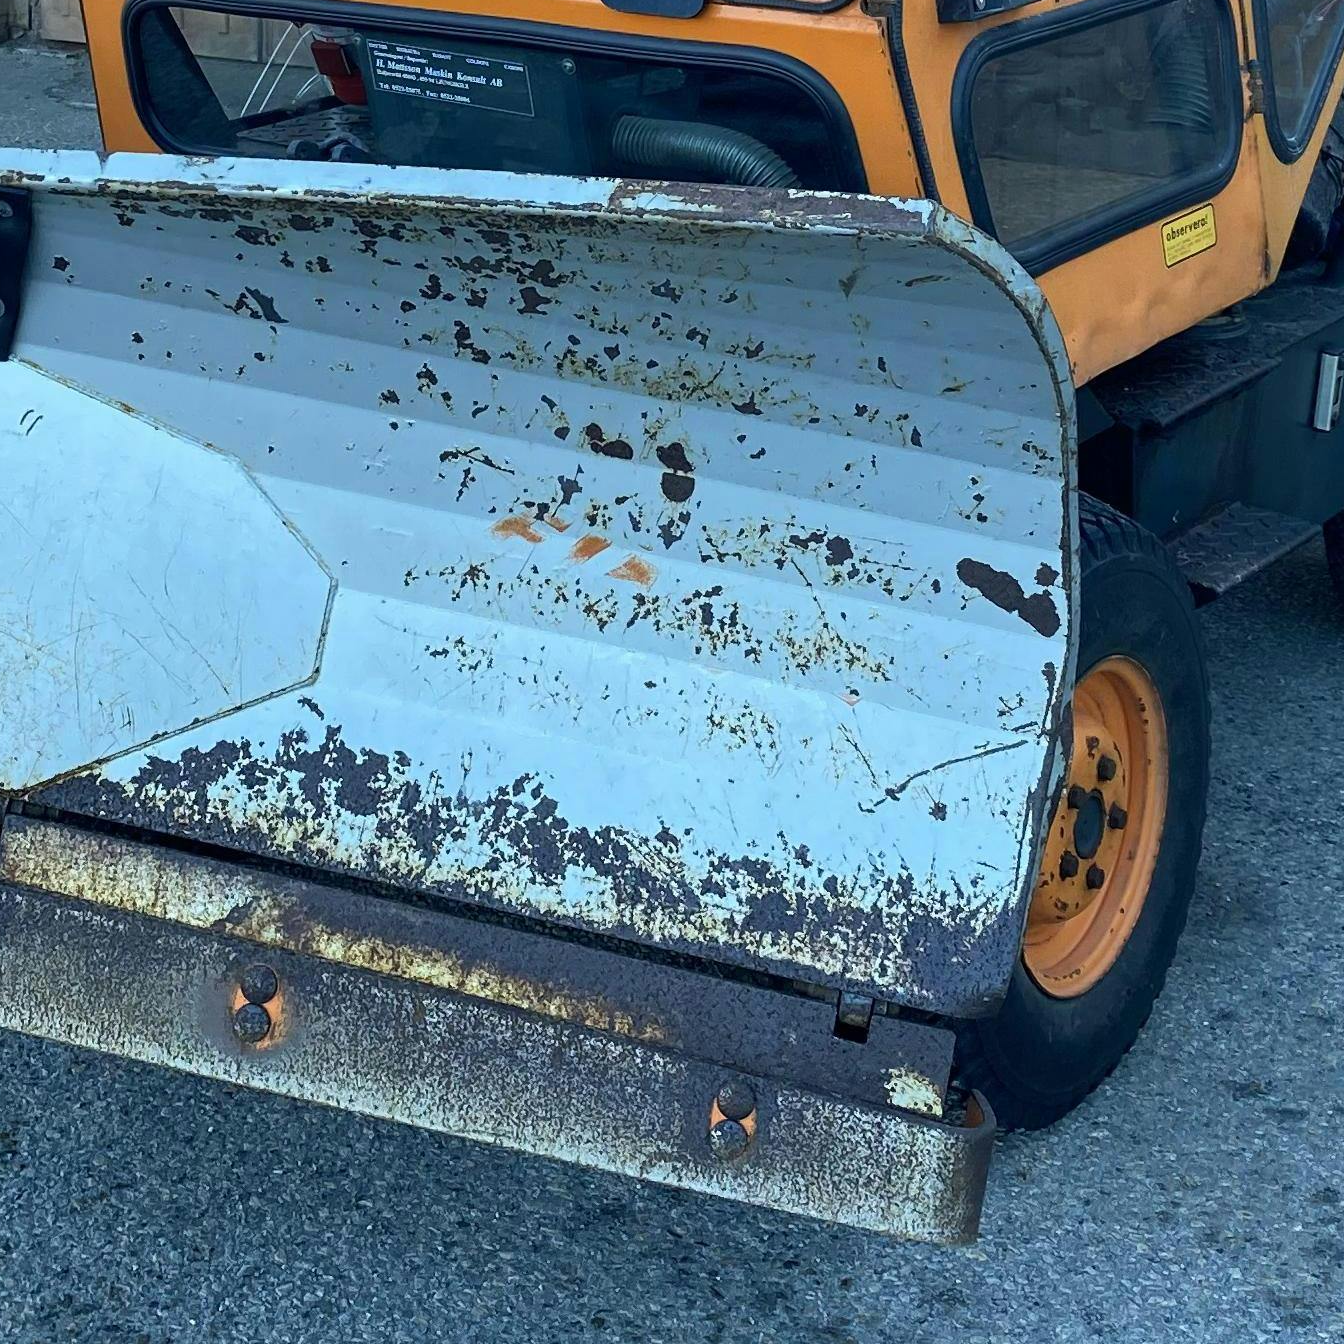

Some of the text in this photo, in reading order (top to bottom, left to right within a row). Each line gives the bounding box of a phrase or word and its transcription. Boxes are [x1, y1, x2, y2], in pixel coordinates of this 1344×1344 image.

[424, 66, 453, 80] Maskin
[490, 78, 503, 87] AB
[1166, 213, 1209, 242] observera!
